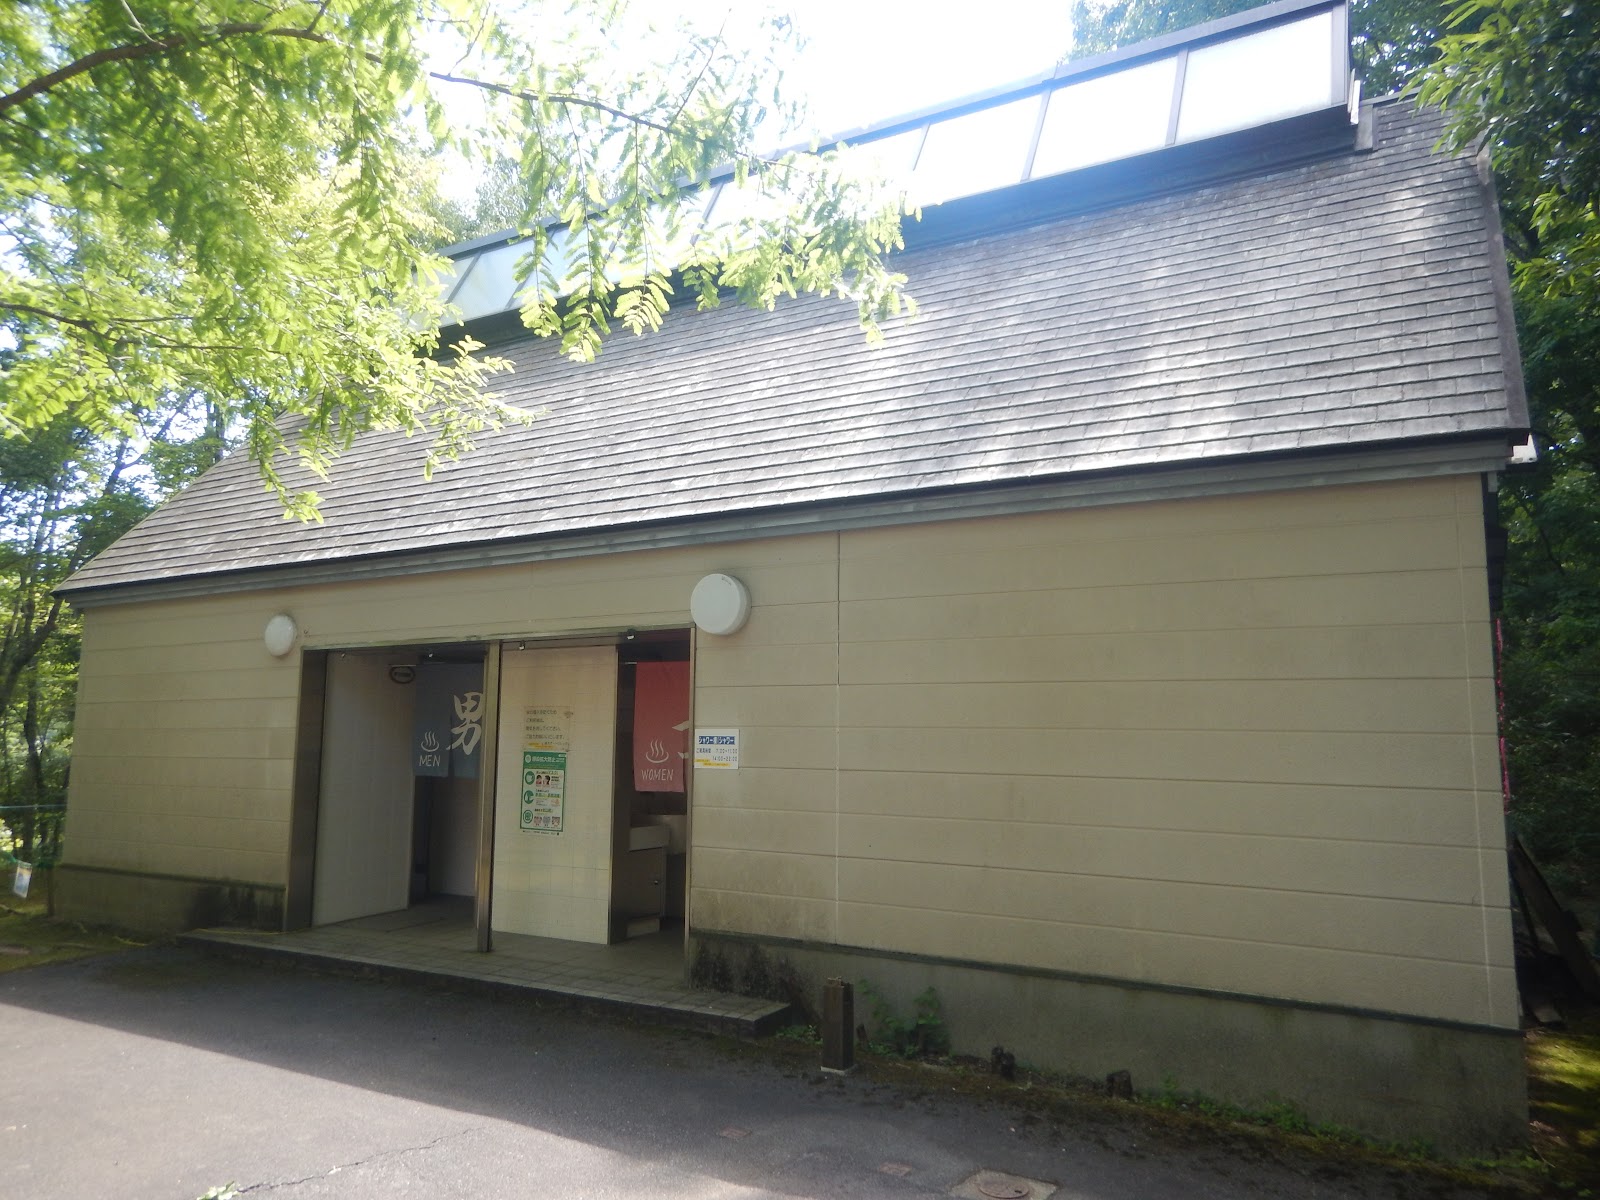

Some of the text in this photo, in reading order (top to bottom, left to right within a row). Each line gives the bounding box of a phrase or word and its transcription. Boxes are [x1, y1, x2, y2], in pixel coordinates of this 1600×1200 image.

[446, 691, 483, 755] 男
[419, 754, 440, 767] MEN
[641, 769, 673, 781] WOMEN
